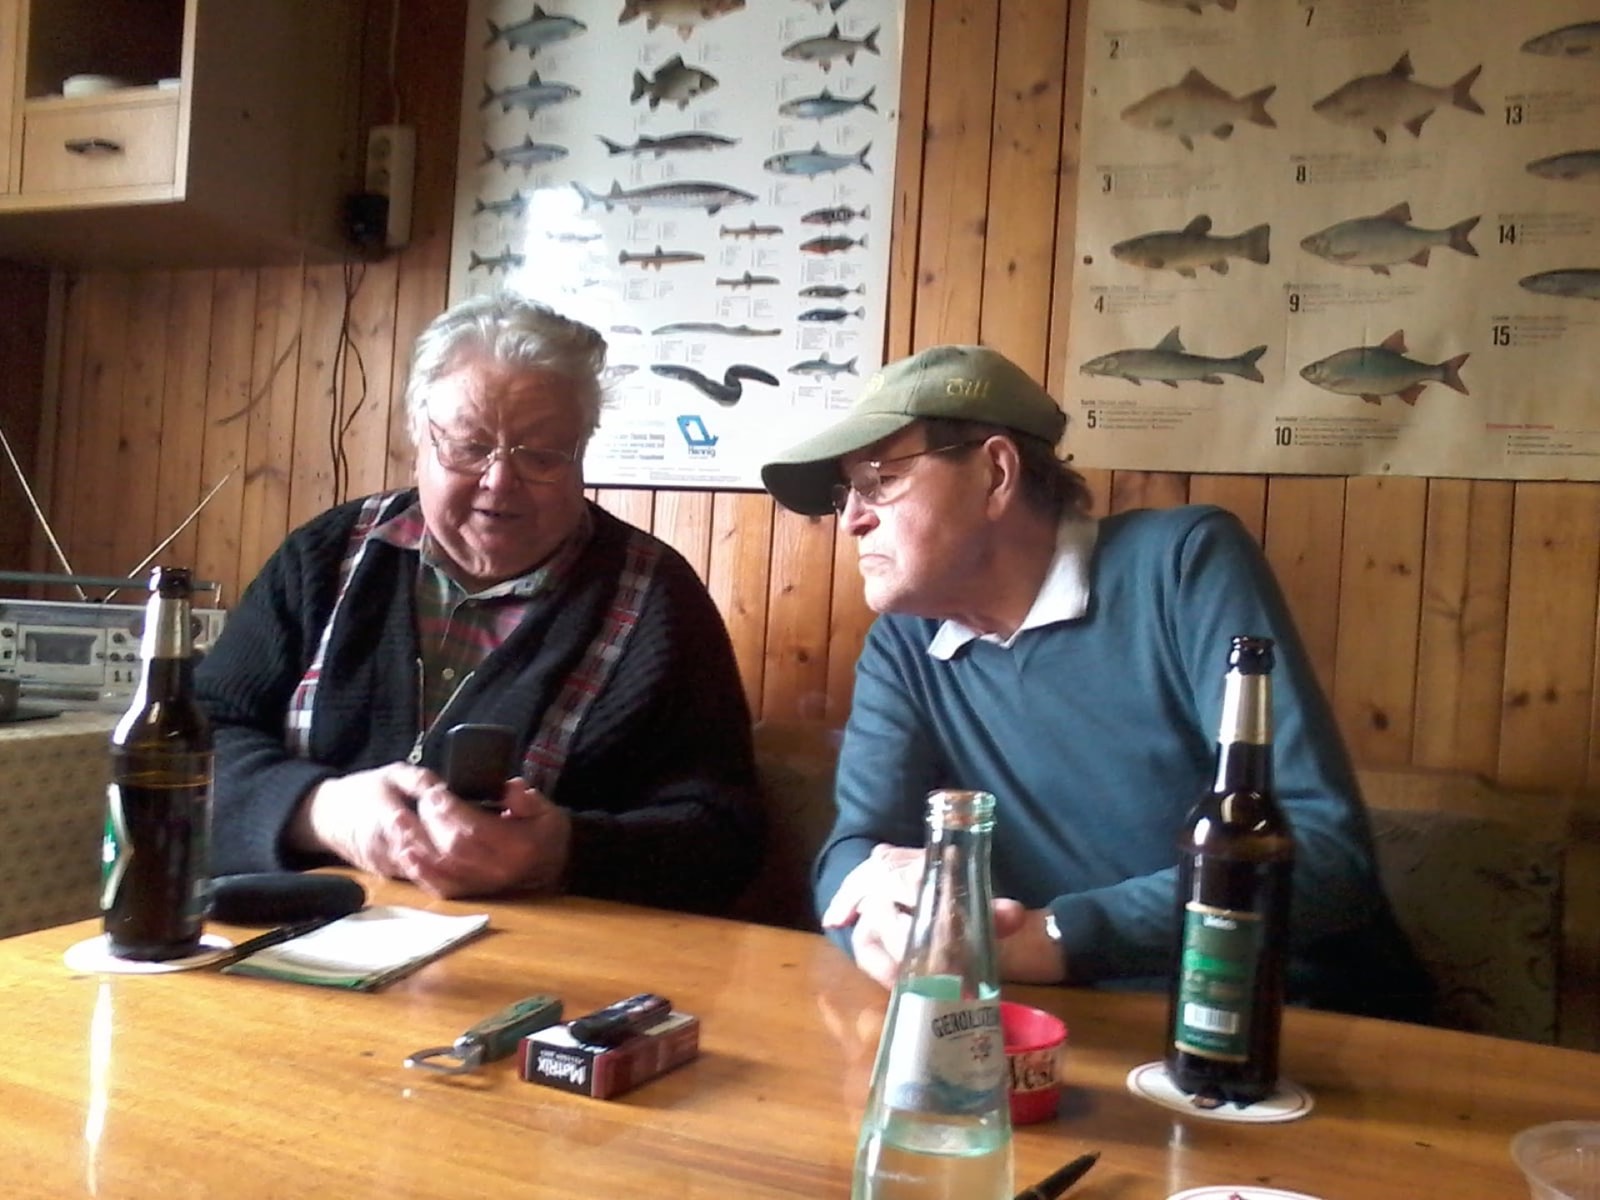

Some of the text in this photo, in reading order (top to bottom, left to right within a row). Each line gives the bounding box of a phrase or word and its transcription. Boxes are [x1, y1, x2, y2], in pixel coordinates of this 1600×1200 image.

[1109, 39, 1120, 59] 2
[1505, 106, 1523, 125] 13
[1102, 175, 1112, 193] 3
[1295, 165, 1306, 183] 8
[1498, 224, 1516, 245] 14
[1094, 295, 1104, 313] 4
[1289, 293, 1300, 313] 9
[1492, 325, 1511, 346] 15
[1087, 409, 1097, 429] 5
[1275, 426, 1292, 447] 10
[687, 446, 716, 458] Hennig
